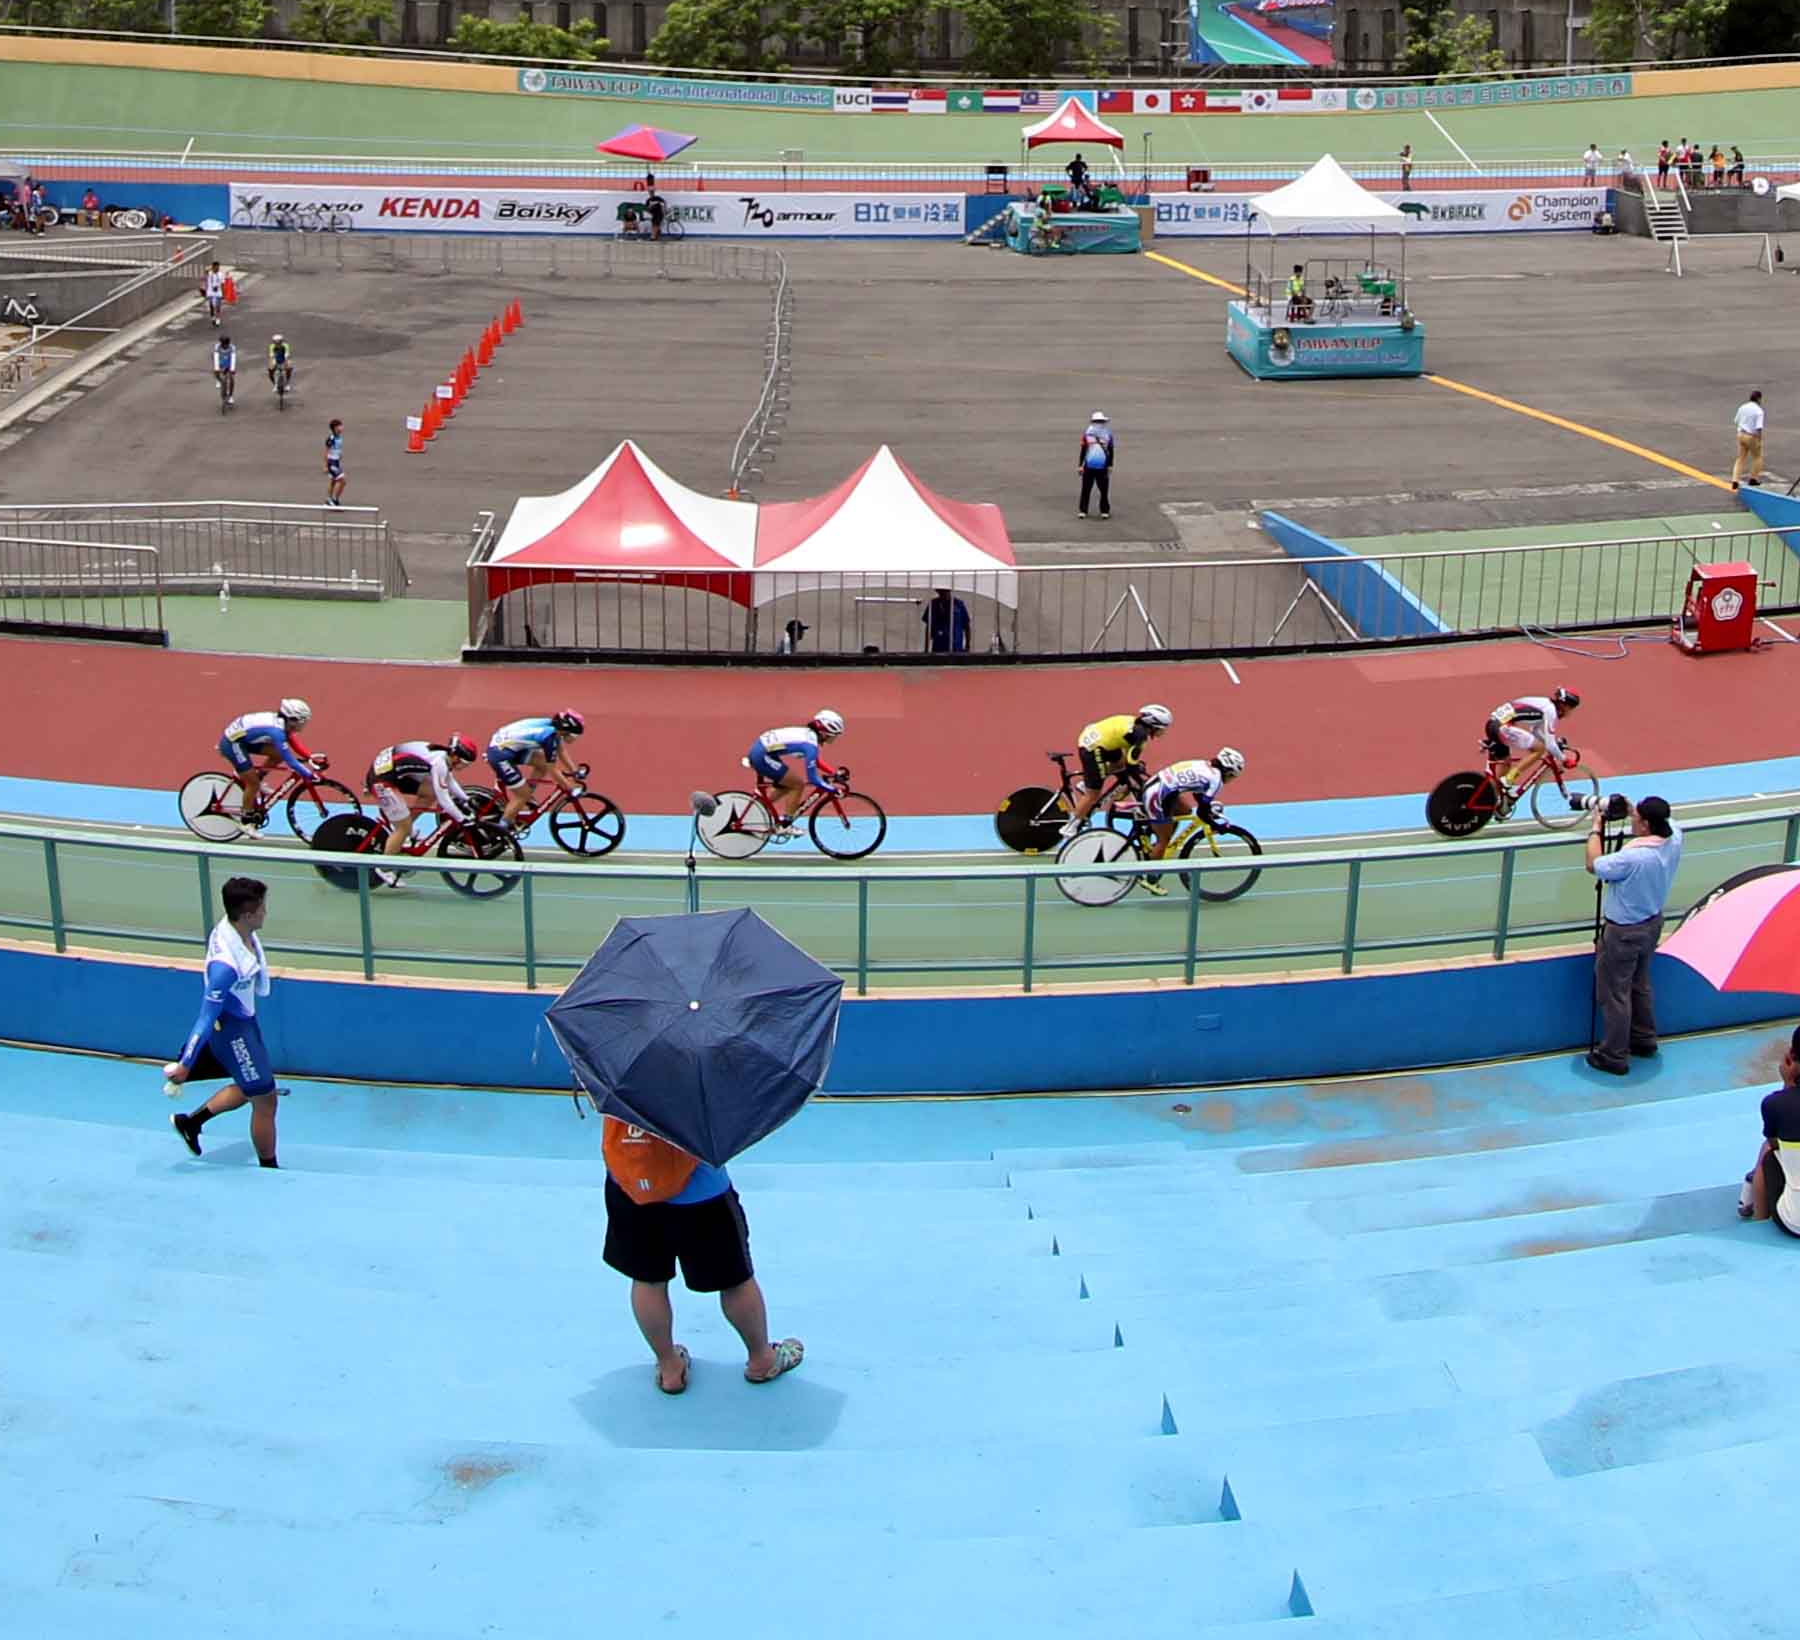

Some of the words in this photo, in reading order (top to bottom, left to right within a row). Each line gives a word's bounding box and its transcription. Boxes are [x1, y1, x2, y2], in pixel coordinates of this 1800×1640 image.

[551, 75, 605, 92] TAIWAN
[607, 80, 639, 94] CUP
[843, 94, 870, 106] UCI
[379, 197, 480, 218] KENDA
[1535, 194, 1599, 209] Champion
[776, 211, 836, 223] armour
[1543, 209, 1592, 223] System
[1176, 769, 1196, 785] 69
